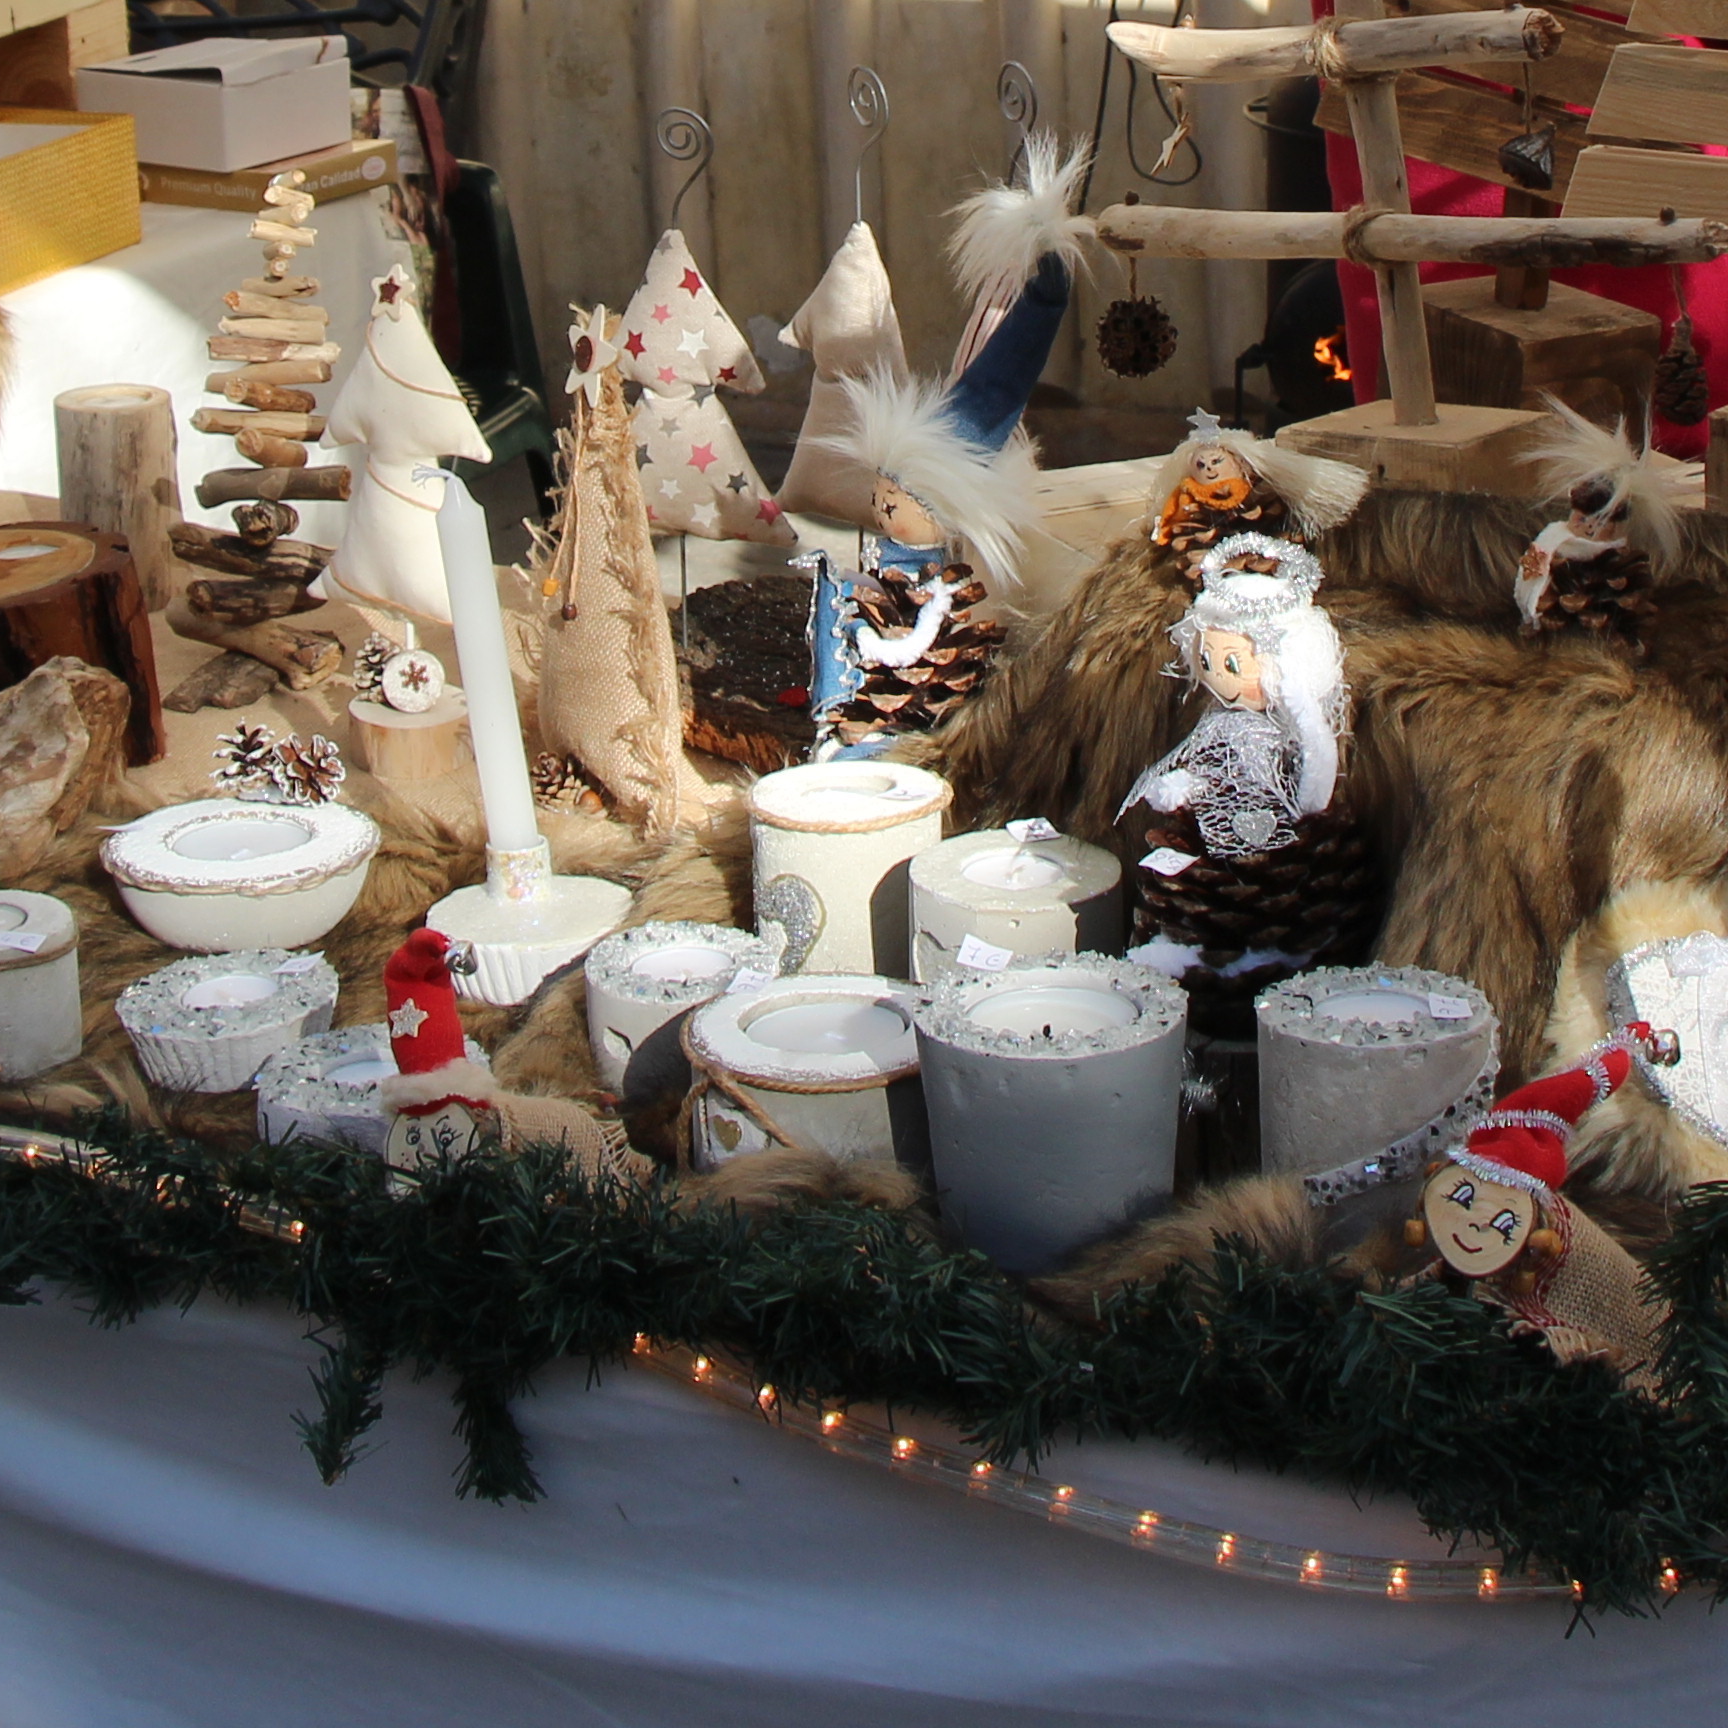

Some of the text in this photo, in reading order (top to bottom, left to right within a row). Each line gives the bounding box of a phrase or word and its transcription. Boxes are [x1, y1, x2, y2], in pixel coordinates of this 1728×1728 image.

[159, 176, 258, 200] Premium Quality
[320, 166, 362, 189] Calidad
